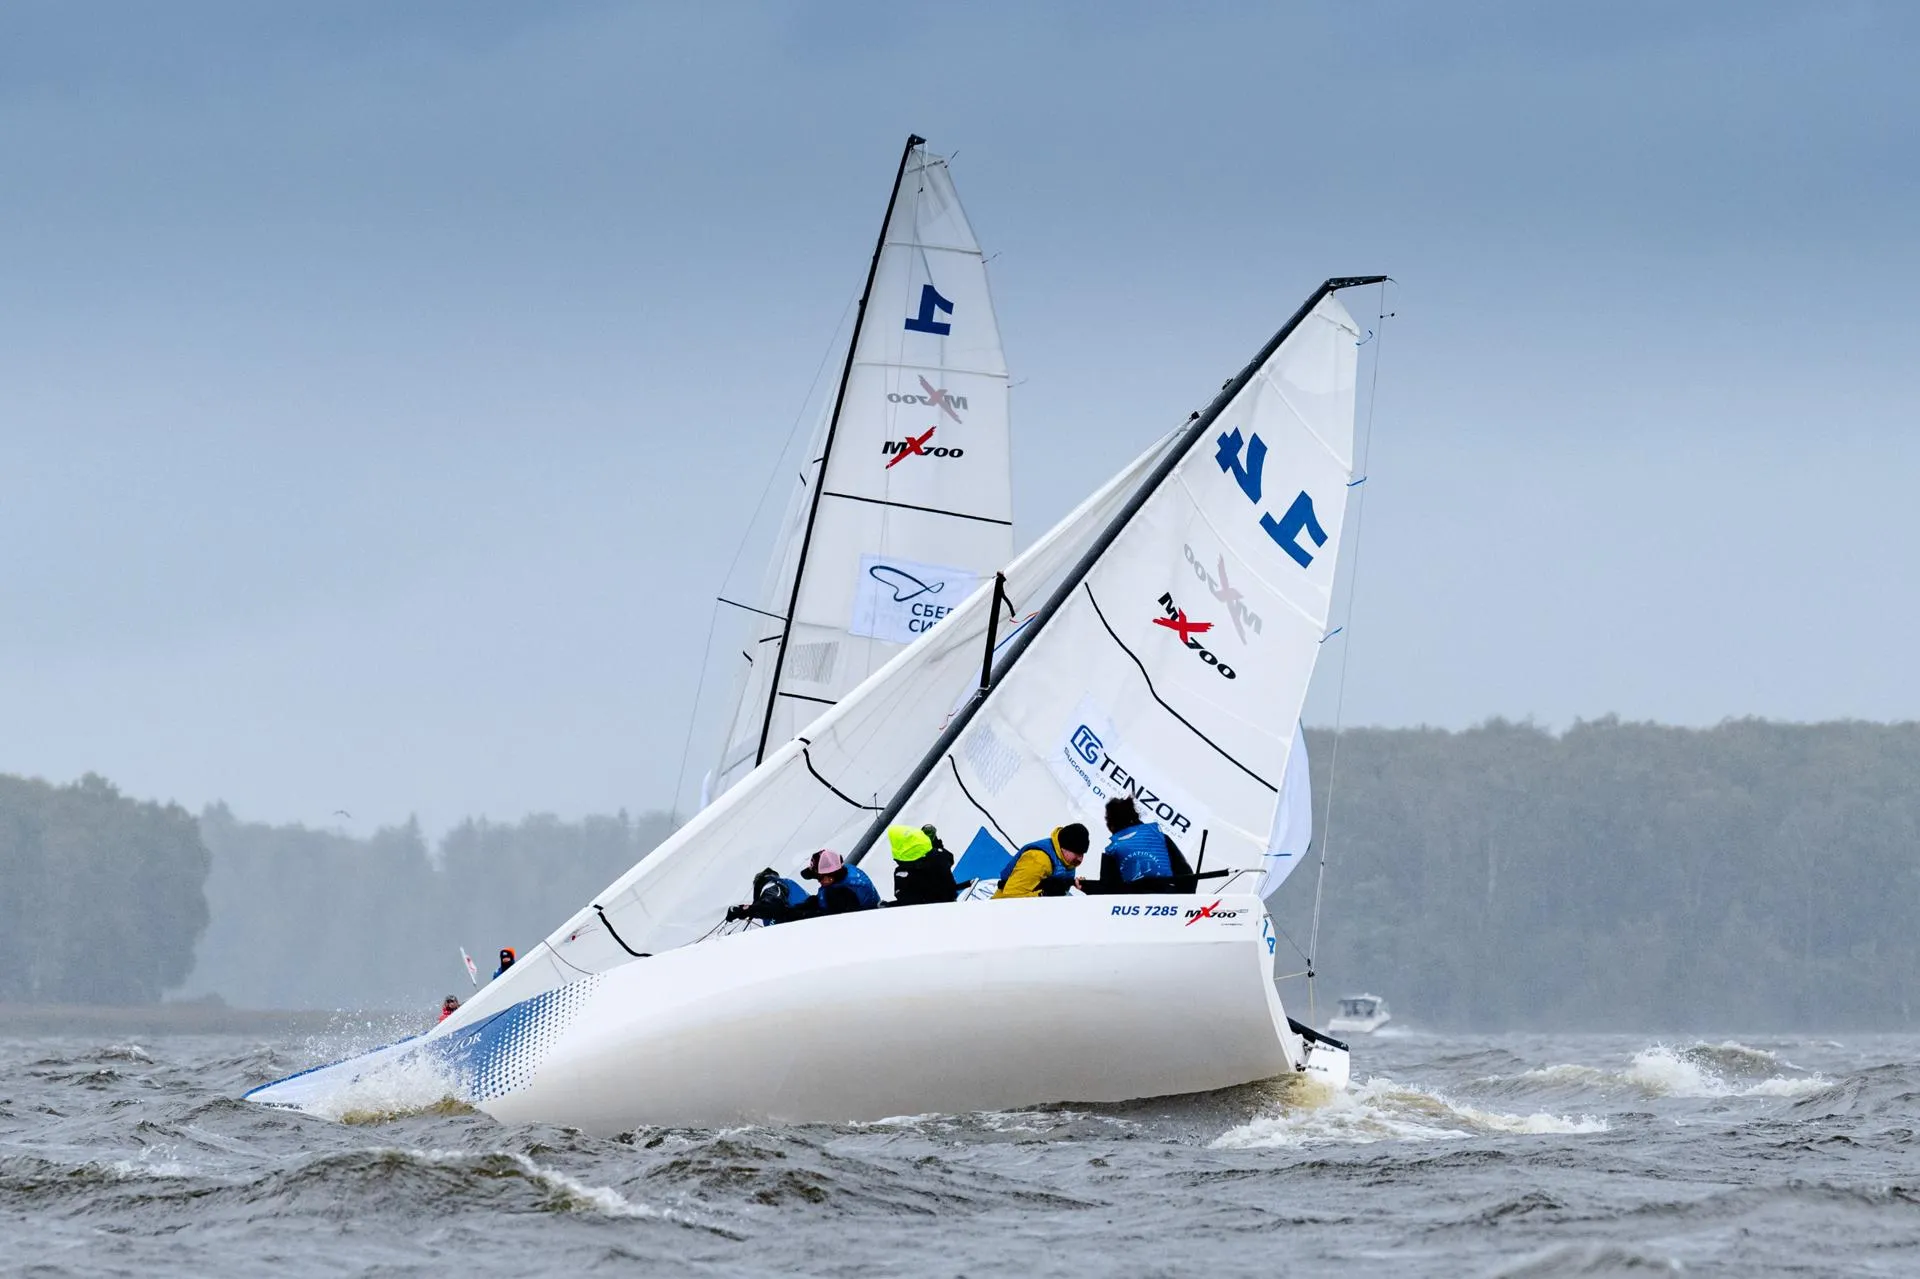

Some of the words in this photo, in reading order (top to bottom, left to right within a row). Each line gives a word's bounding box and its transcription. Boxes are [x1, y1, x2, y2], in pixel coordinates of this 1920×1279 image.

[882, 425, 964, 469] MX700
[908, 619, 938, 633] СИ
[1152, 591, 1237, 680] MX700
[1064, 747, 1092, 787] Success
[1100, 752, 1192, 834] TENZOR
[1111, 905, 1140, 917] RUS
[1144, 905, 1178, 917] 7285
[1184, 898, 1237, 927] MX700
